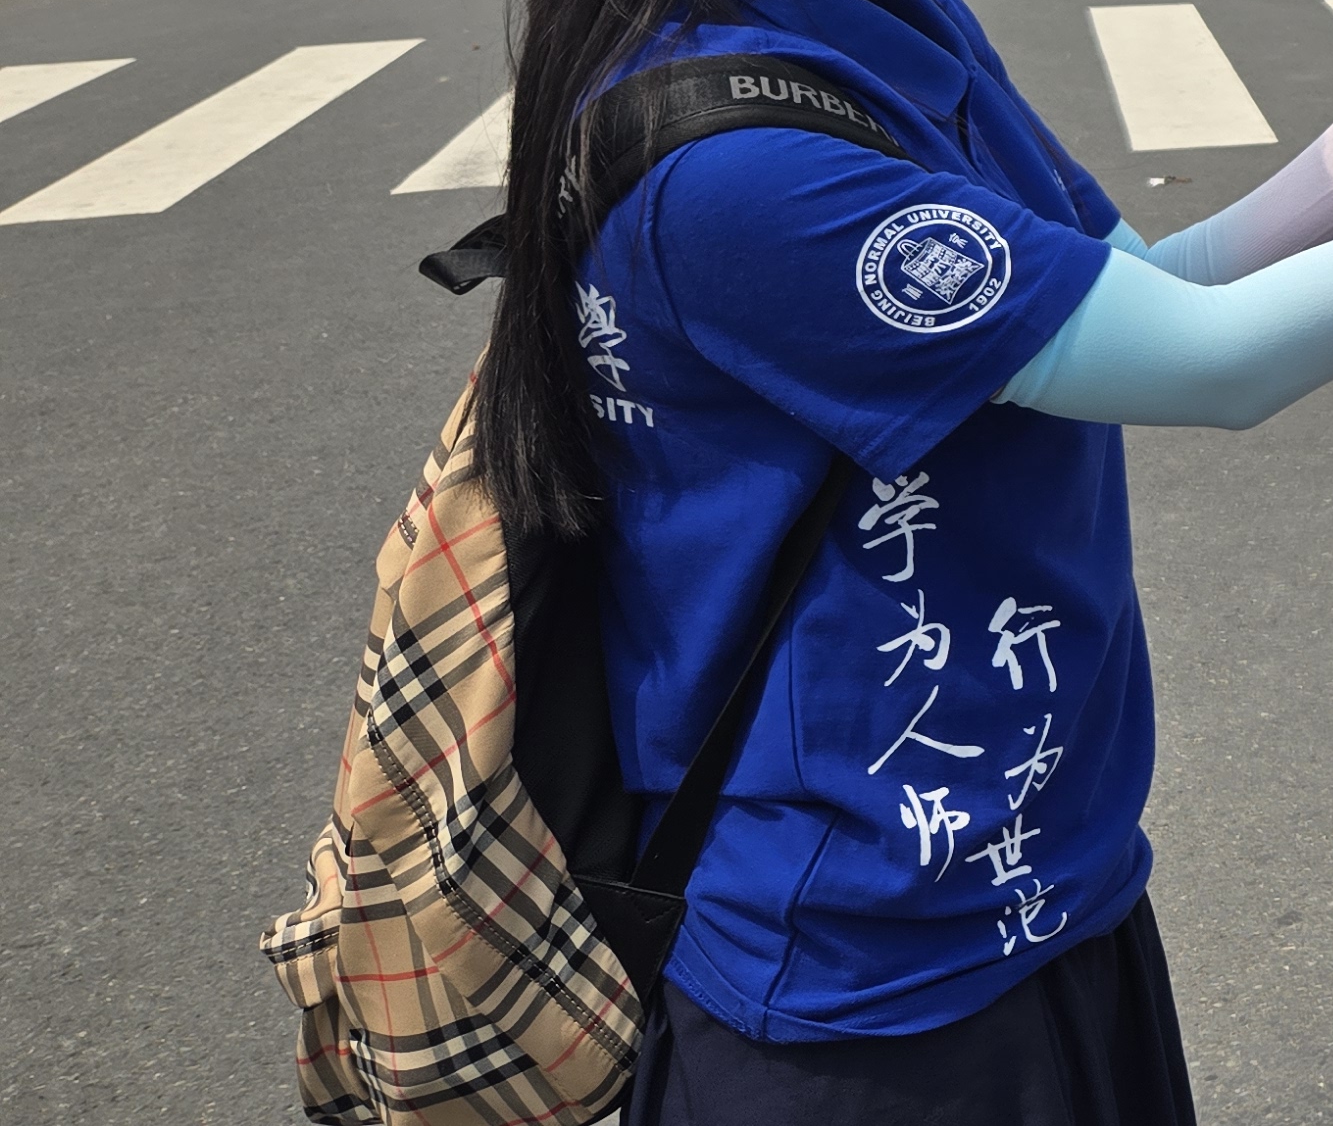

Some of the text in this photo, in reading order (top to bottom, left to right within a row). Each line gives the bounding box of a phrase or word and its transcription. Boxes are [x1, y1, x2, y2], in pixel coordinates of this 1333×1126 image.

[728, 75, 900, 147] BURBE
[864, 209, 1002, 327] BEIJING NORMAL UNIVERSITY
[968, 277, 1002, 312] 1902
[857, 470, 985, 883] 学为人师
